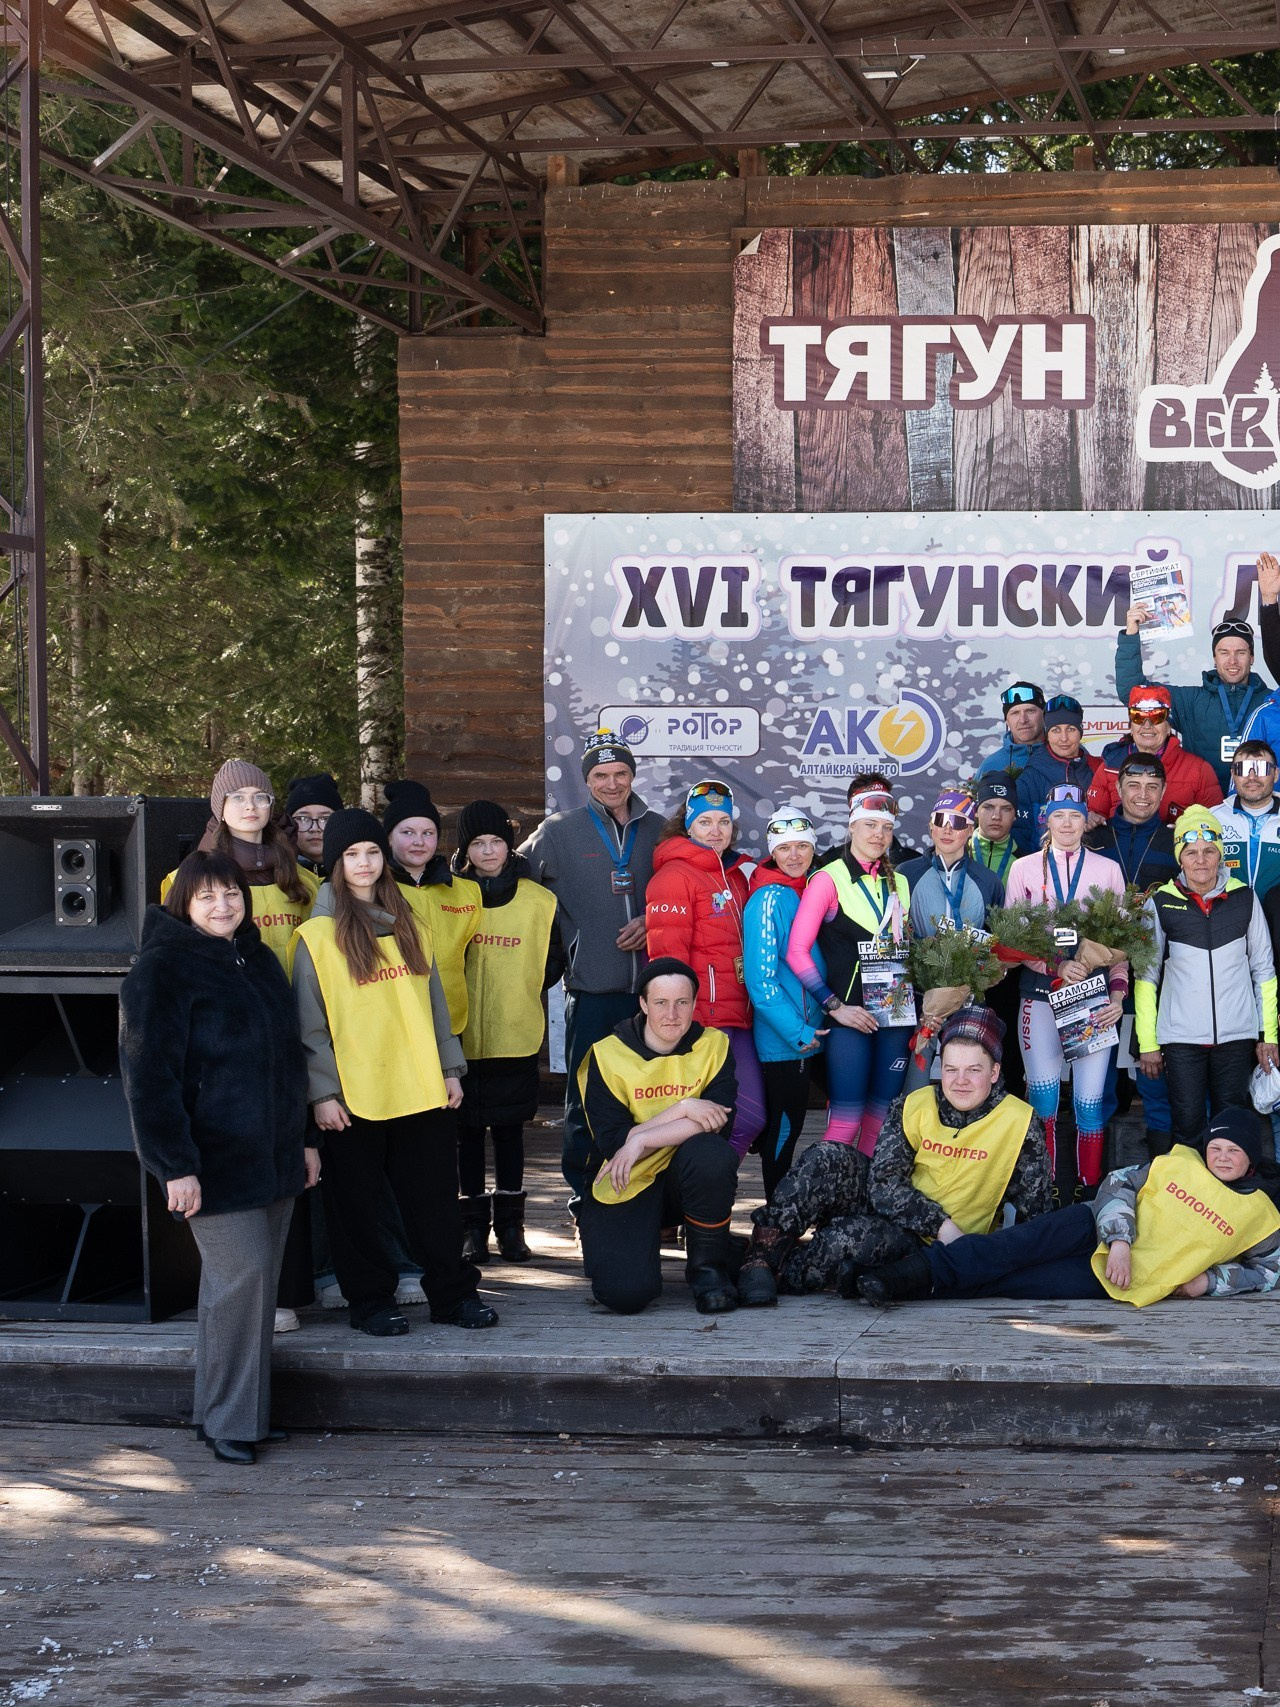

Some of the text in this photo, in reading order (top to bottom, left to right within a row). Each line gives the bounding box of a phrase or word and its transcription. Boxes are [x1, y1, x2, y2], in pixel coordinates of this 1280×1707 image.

[767, 322, 1089, 402] ТЯГУН
[1130, 563, 1180, 579] СЕРТИФИКАТ
[621, 565, 751, 628] XVI
[791, 549, 1170, 629] ТЯГУНСКИ
[669, 744, 704, 752] ТРАДИЦИЯ
[800, 762, 897, 775] АЛТАЙКРАЙЭНЕРГО
[252, 913, 302, 928] ЛОНТЕР
[651, 903, 687, 915] MOAX
[473, 933, 521, 948] ОНТЕР
[1050, 977, 1104, 1003] ГРАМОТА
[1053, 986, 1106, 1010] ЗА ВТОРОЕ МЕСТО
[1022, 998, 1034, 1051] RUSSIA
[921, 1138, 989, 1161] ОЛОНТЕР
[1165, 1181, 1235, 1237] ВОЛОНТЕР
